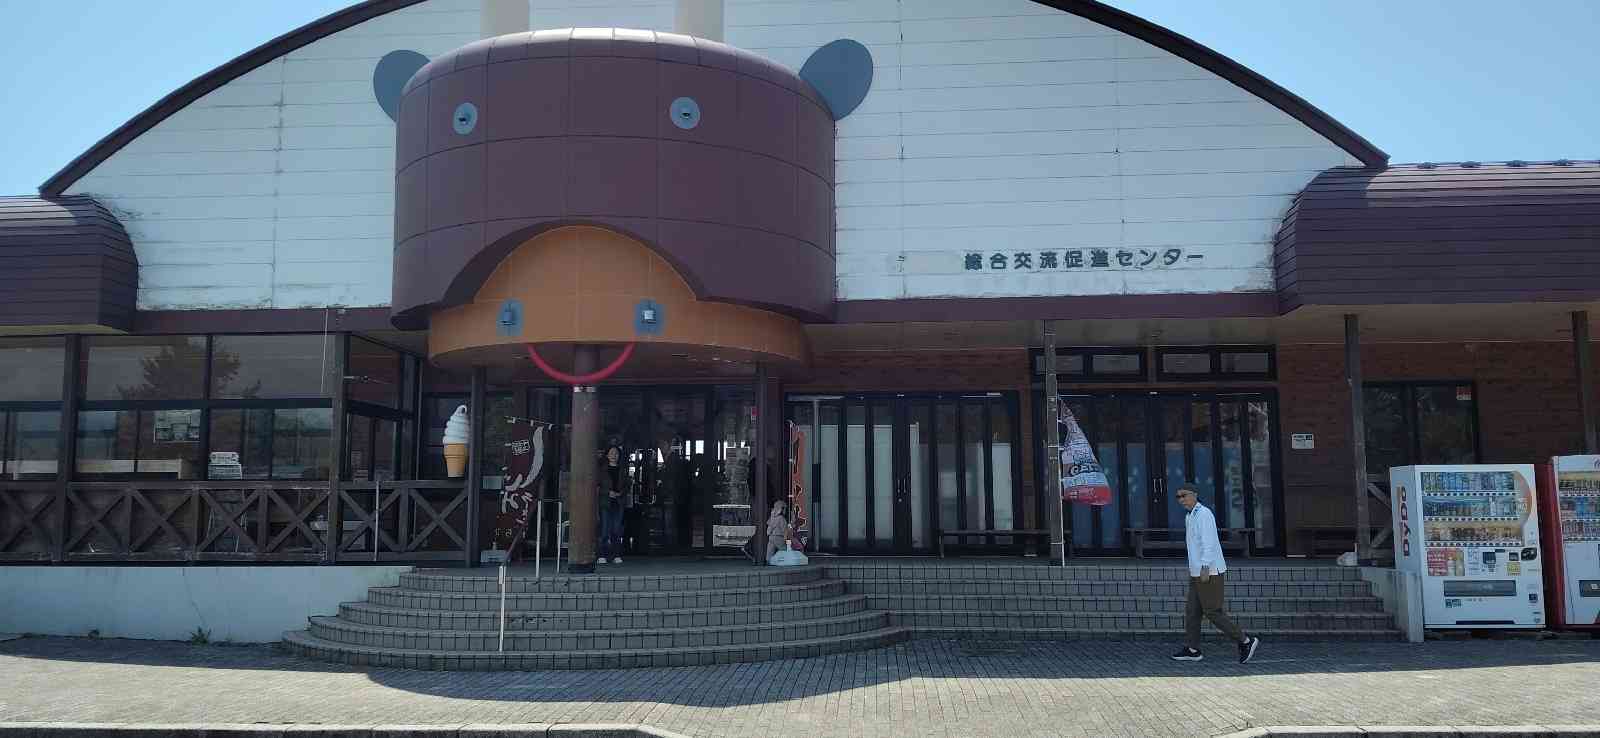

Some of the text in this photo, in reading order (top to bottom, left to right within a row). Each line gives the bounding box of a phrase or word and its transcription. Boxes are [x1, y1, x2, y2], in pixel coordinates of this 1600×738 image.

[964, 248, 1205, 270] 総合交流促進センター
